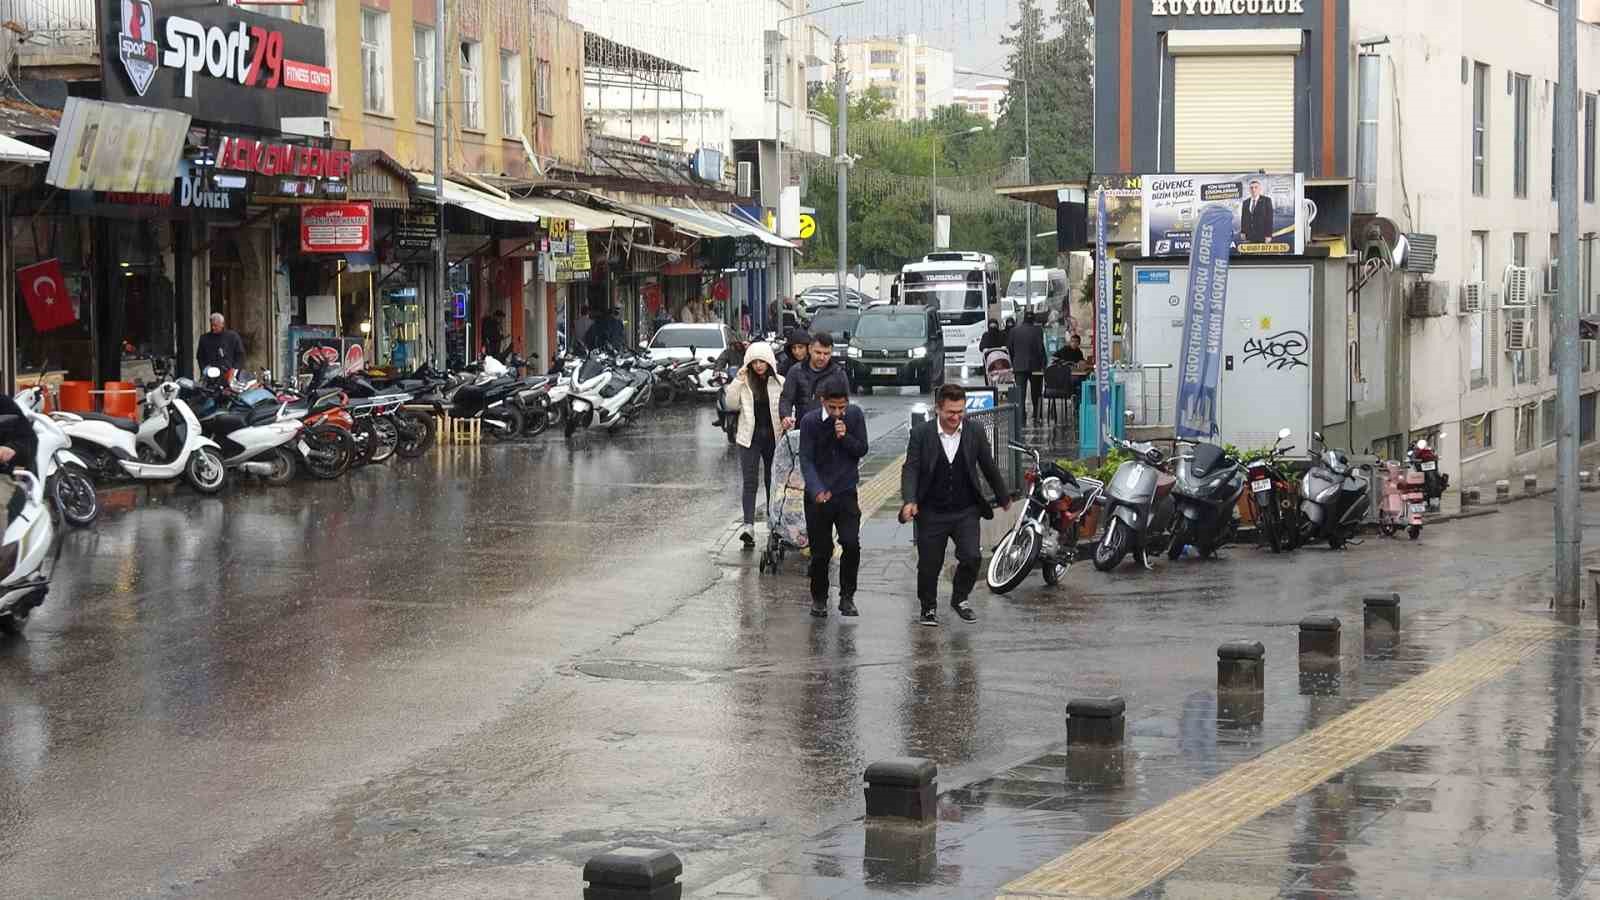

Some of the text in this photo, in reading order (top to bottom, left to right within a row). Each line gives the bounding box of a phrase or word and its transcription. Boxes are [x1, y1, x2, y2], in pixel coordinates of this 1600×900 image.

[1151, 0, 1304, 16] KUYUMCULUK
[286, 66, 331, 86] FITNESS CENTER
[1152, 179, 1193, 191] GÜVENCE
[1200, 224, 1214, 265] ADRES
